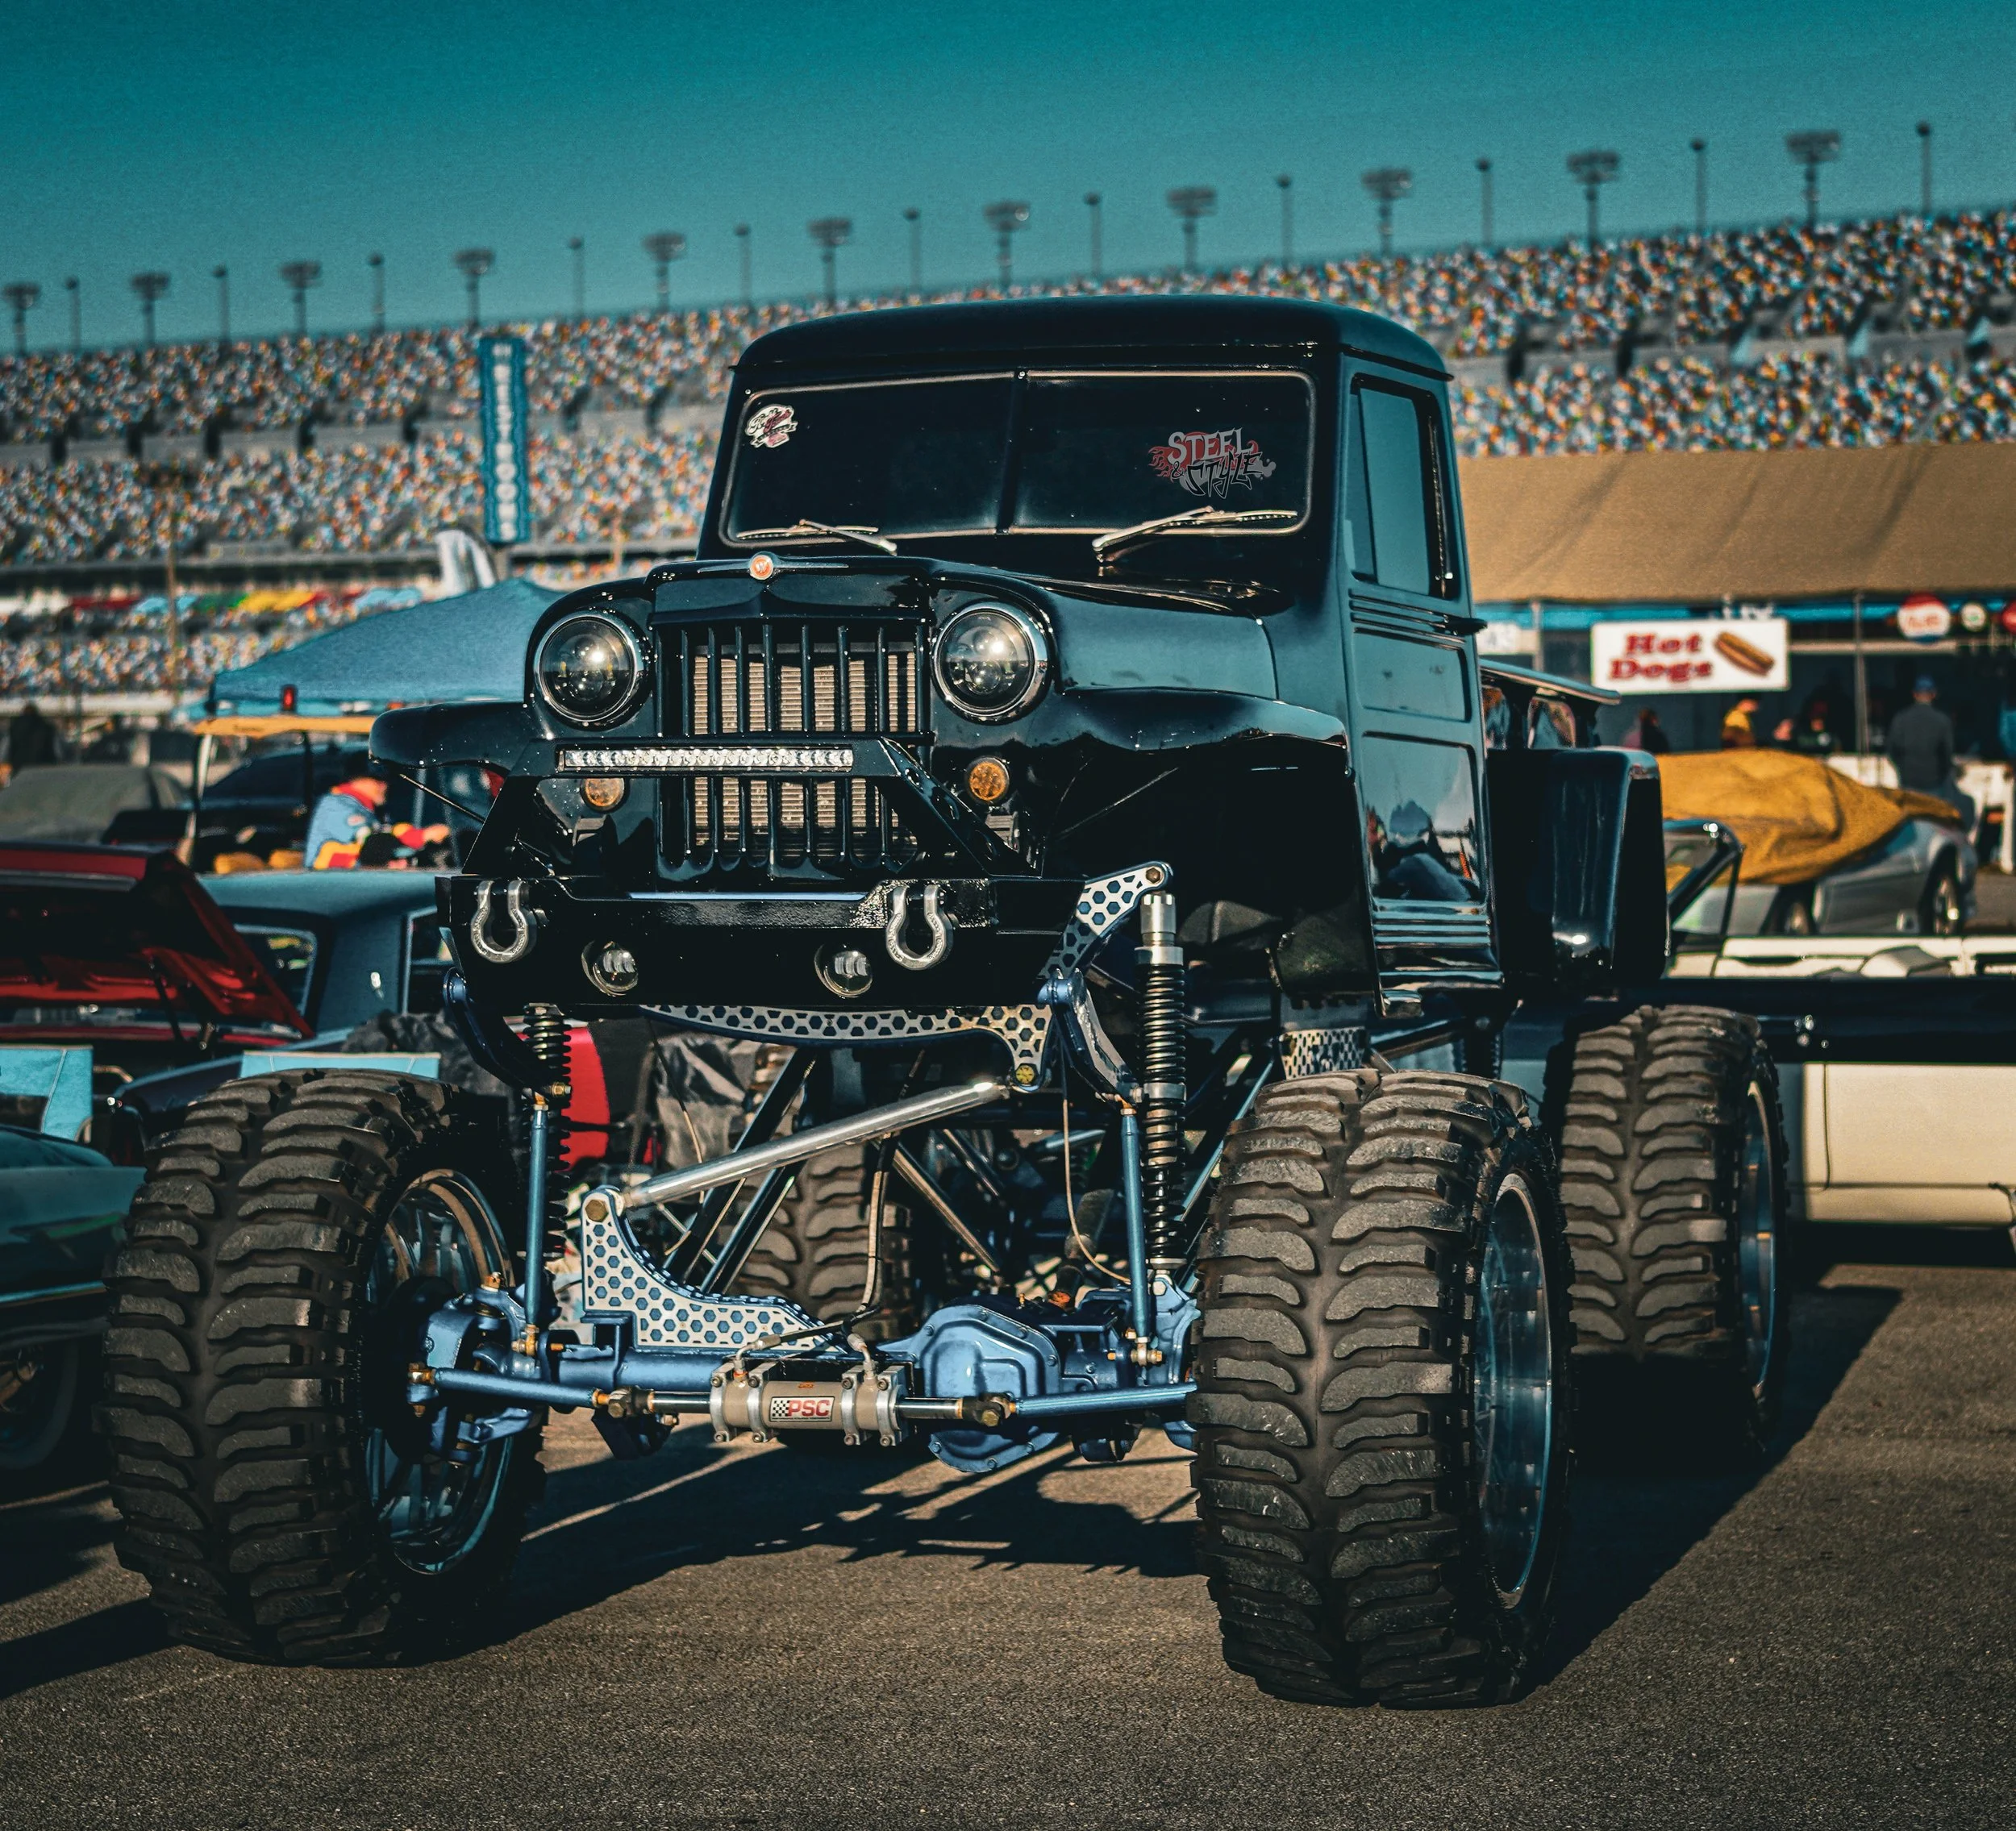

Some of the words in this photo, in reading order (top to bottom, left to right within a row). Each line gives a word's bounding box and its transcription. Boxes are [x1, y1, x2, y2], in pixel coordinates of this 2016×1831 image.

[1167, 428, 1255, 465] STEEL
[1185, 450, 1263, 499] STYLE
[1625, 633, 1701, 654] Hot
[1609, 659, 1713, 684] Dogs
[787, 1400, 830, 1417] PSC
